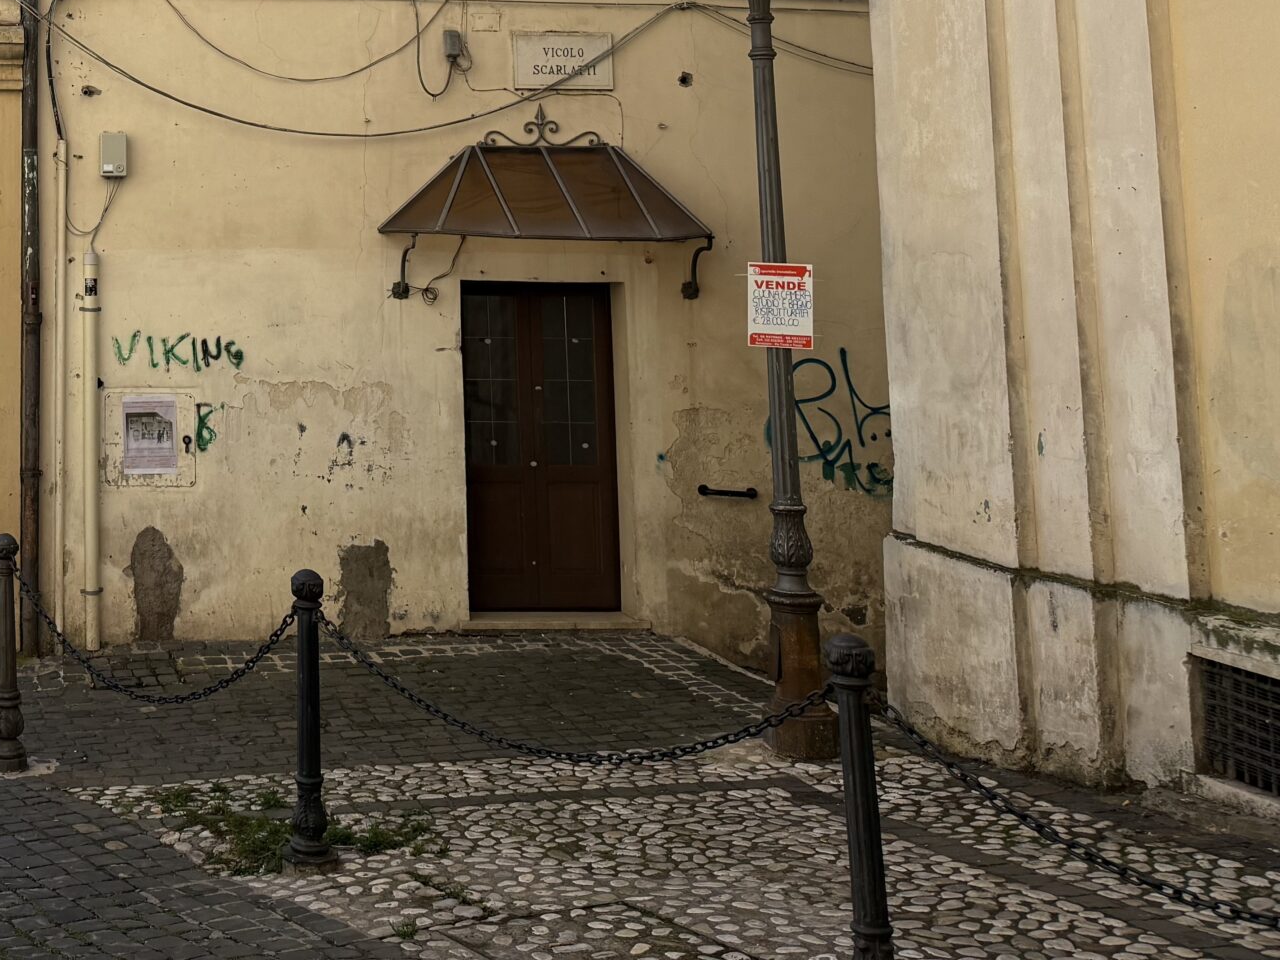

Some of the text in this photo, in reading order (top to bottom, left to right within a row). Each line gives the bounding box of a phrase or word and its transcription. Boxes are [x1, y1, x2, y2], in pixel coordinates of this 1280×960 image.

[542, 47, 585, 58] VICOLO
[754, 279, 807, 291] VENDE
[753, 297, 779, 308] STUDIO
[112, 330, 244, 373] VIKING
